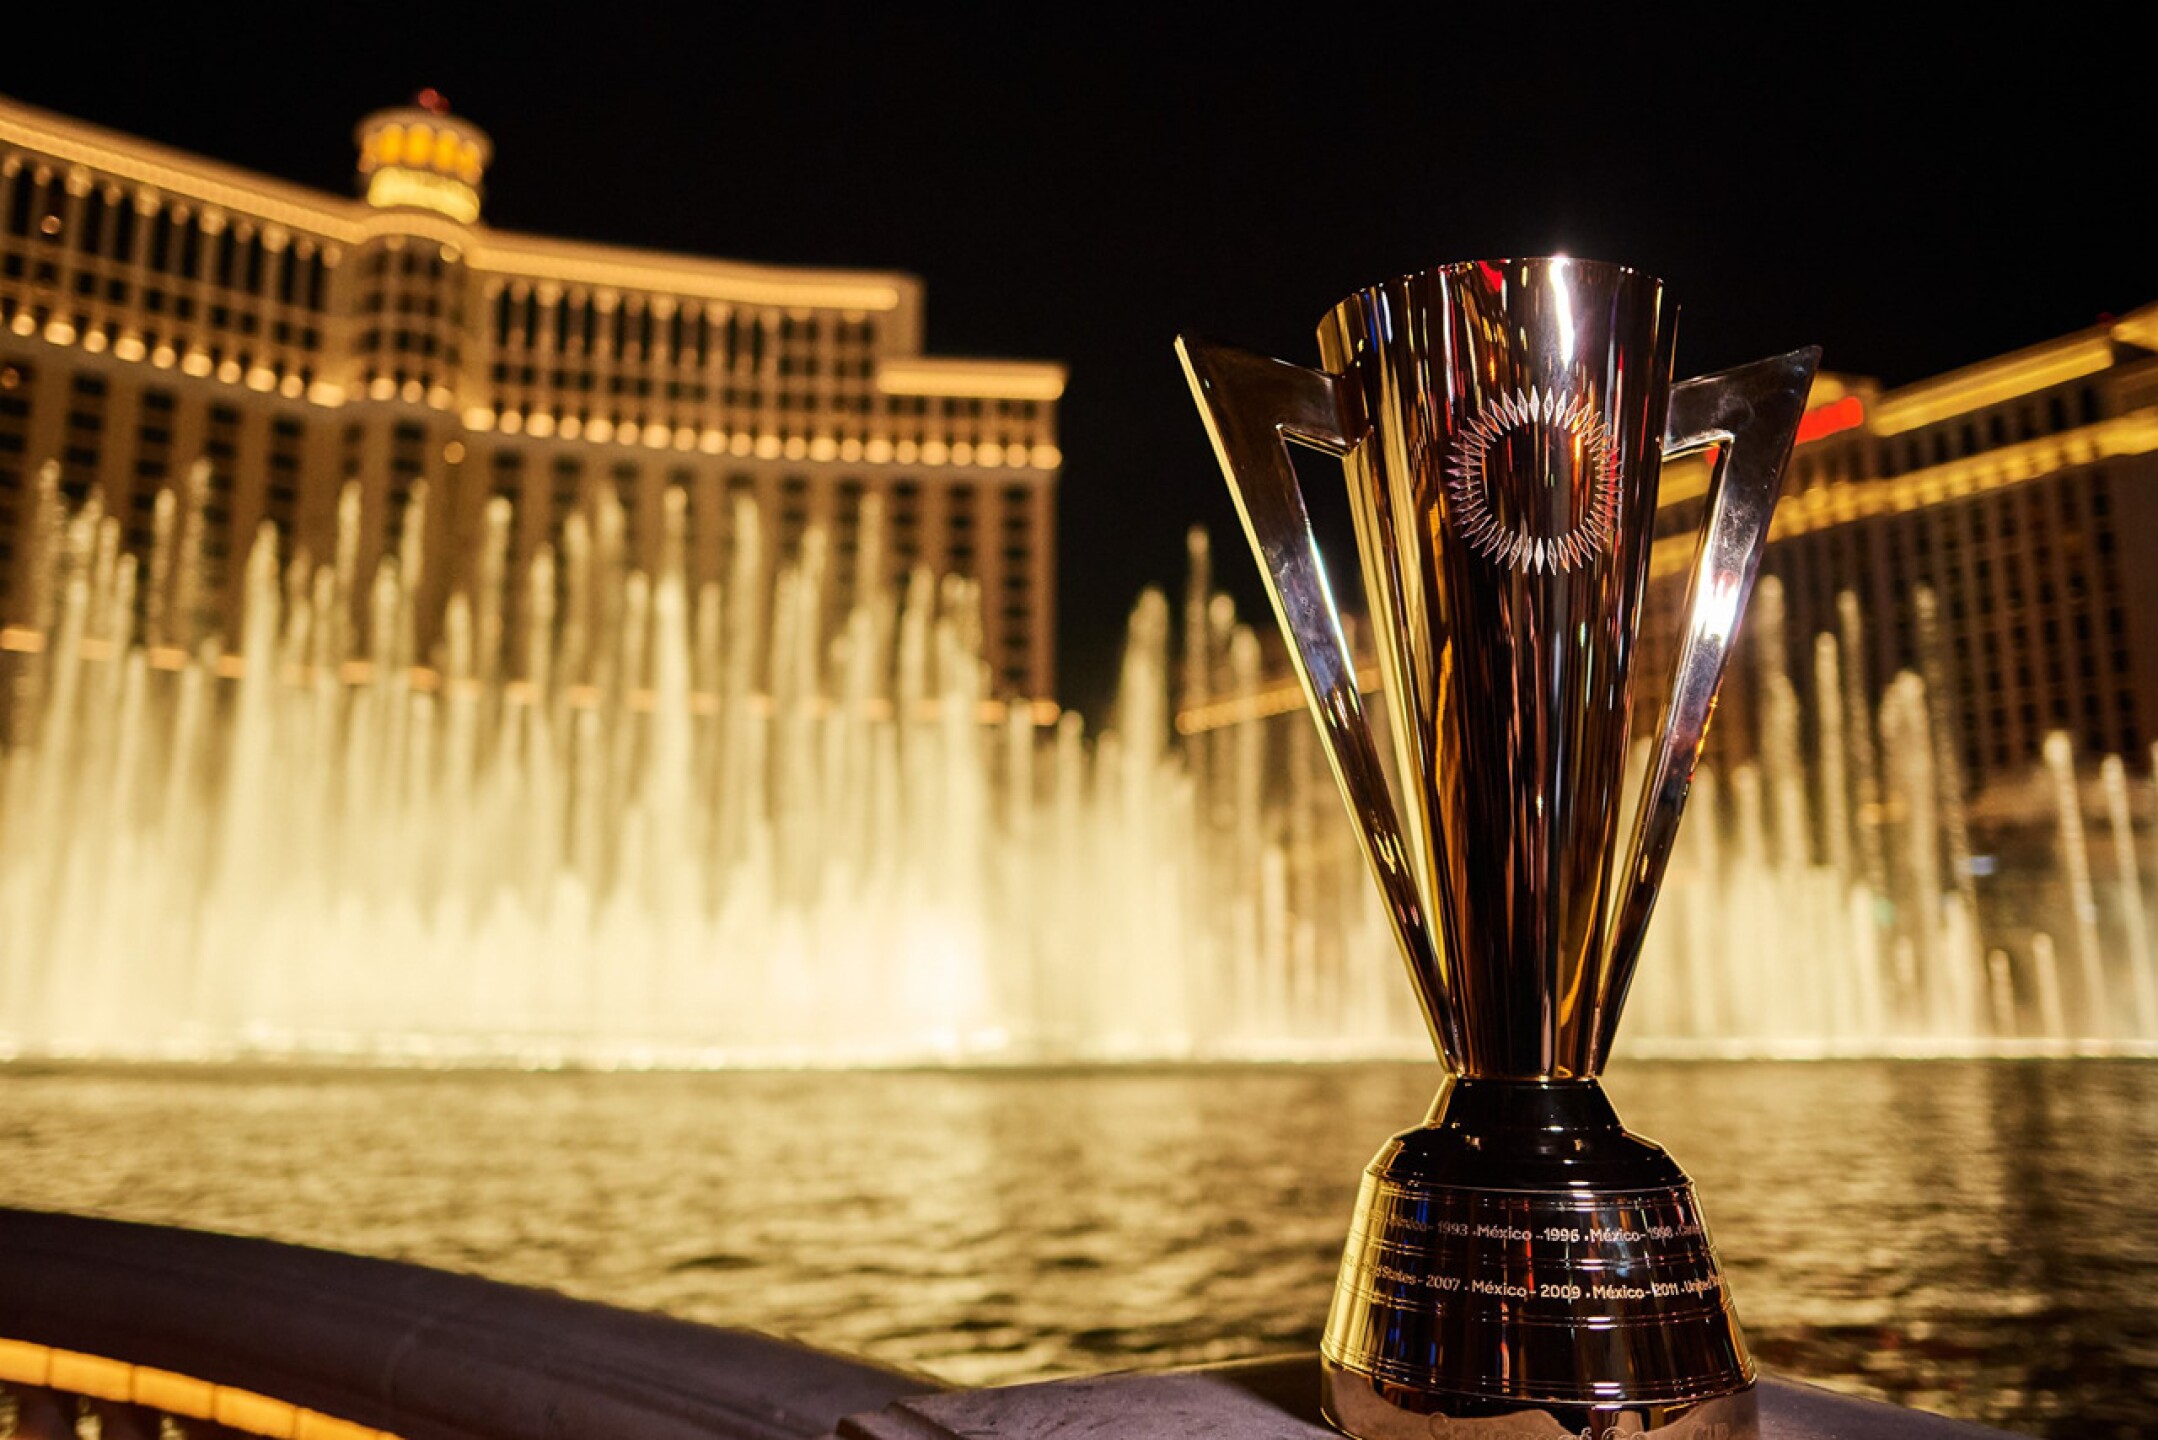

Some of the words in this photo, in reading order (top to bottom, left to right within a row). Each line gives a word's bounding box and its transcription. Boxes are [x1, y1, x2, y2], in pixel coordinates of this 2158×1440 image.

[1438, 1221, 1468, 1236] 1993
[1426, 1274, 1460, 1291] 2007
[1540, 1284, 1581, 1299] 2009
